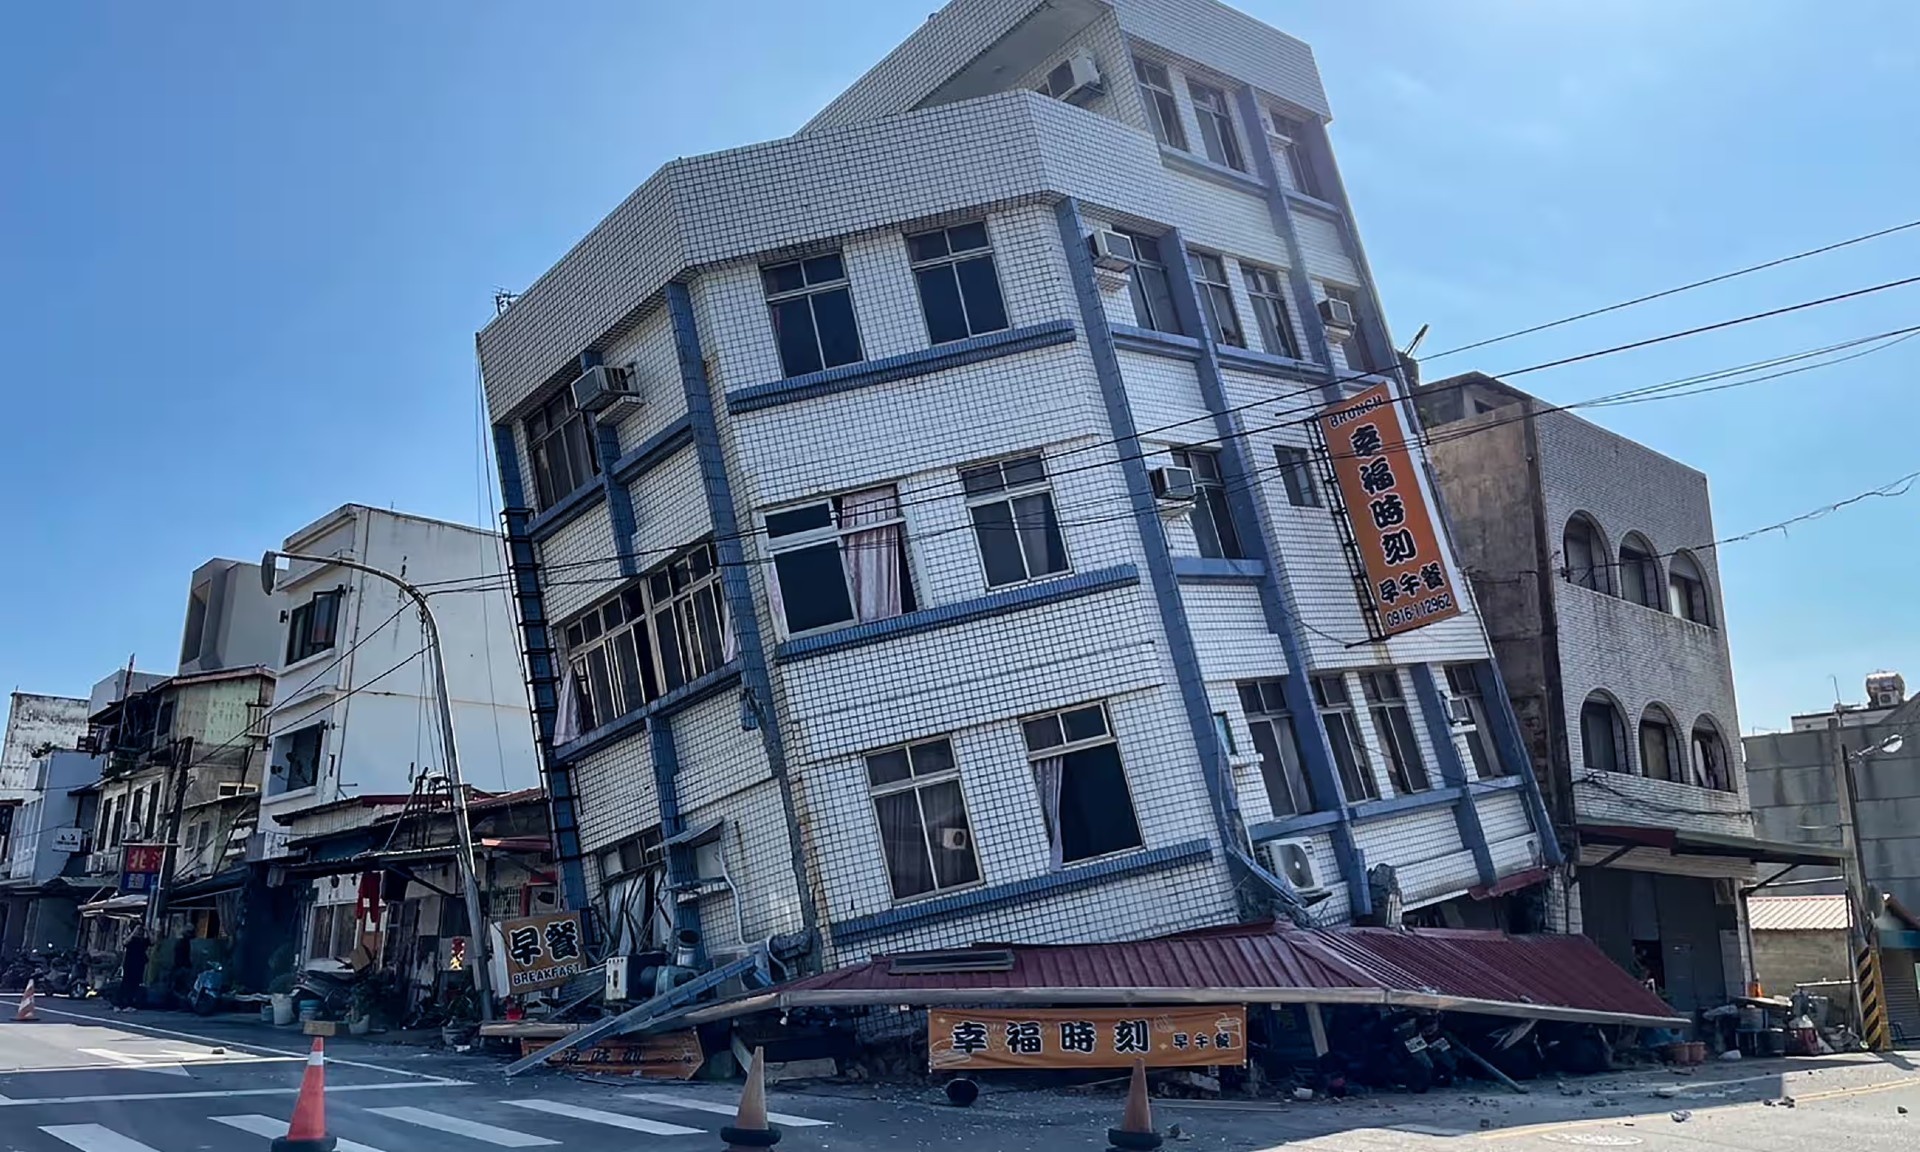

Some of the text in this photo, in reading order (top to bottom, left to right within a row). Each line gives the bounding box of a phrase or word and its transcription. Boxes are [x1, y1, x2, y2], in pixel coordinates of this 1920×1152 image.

[1329, 394, 1382, 429] BRUNCH
[1350, 423, 1417, 565] 幸福時刻
[1379, 561, 1444, 604] 早午餐
[509, 920, 580, 967] 早餐
[513, 964, 581, 986] BREAKFAST
[951, 1019, 1151, 1055] 幸福時刻
